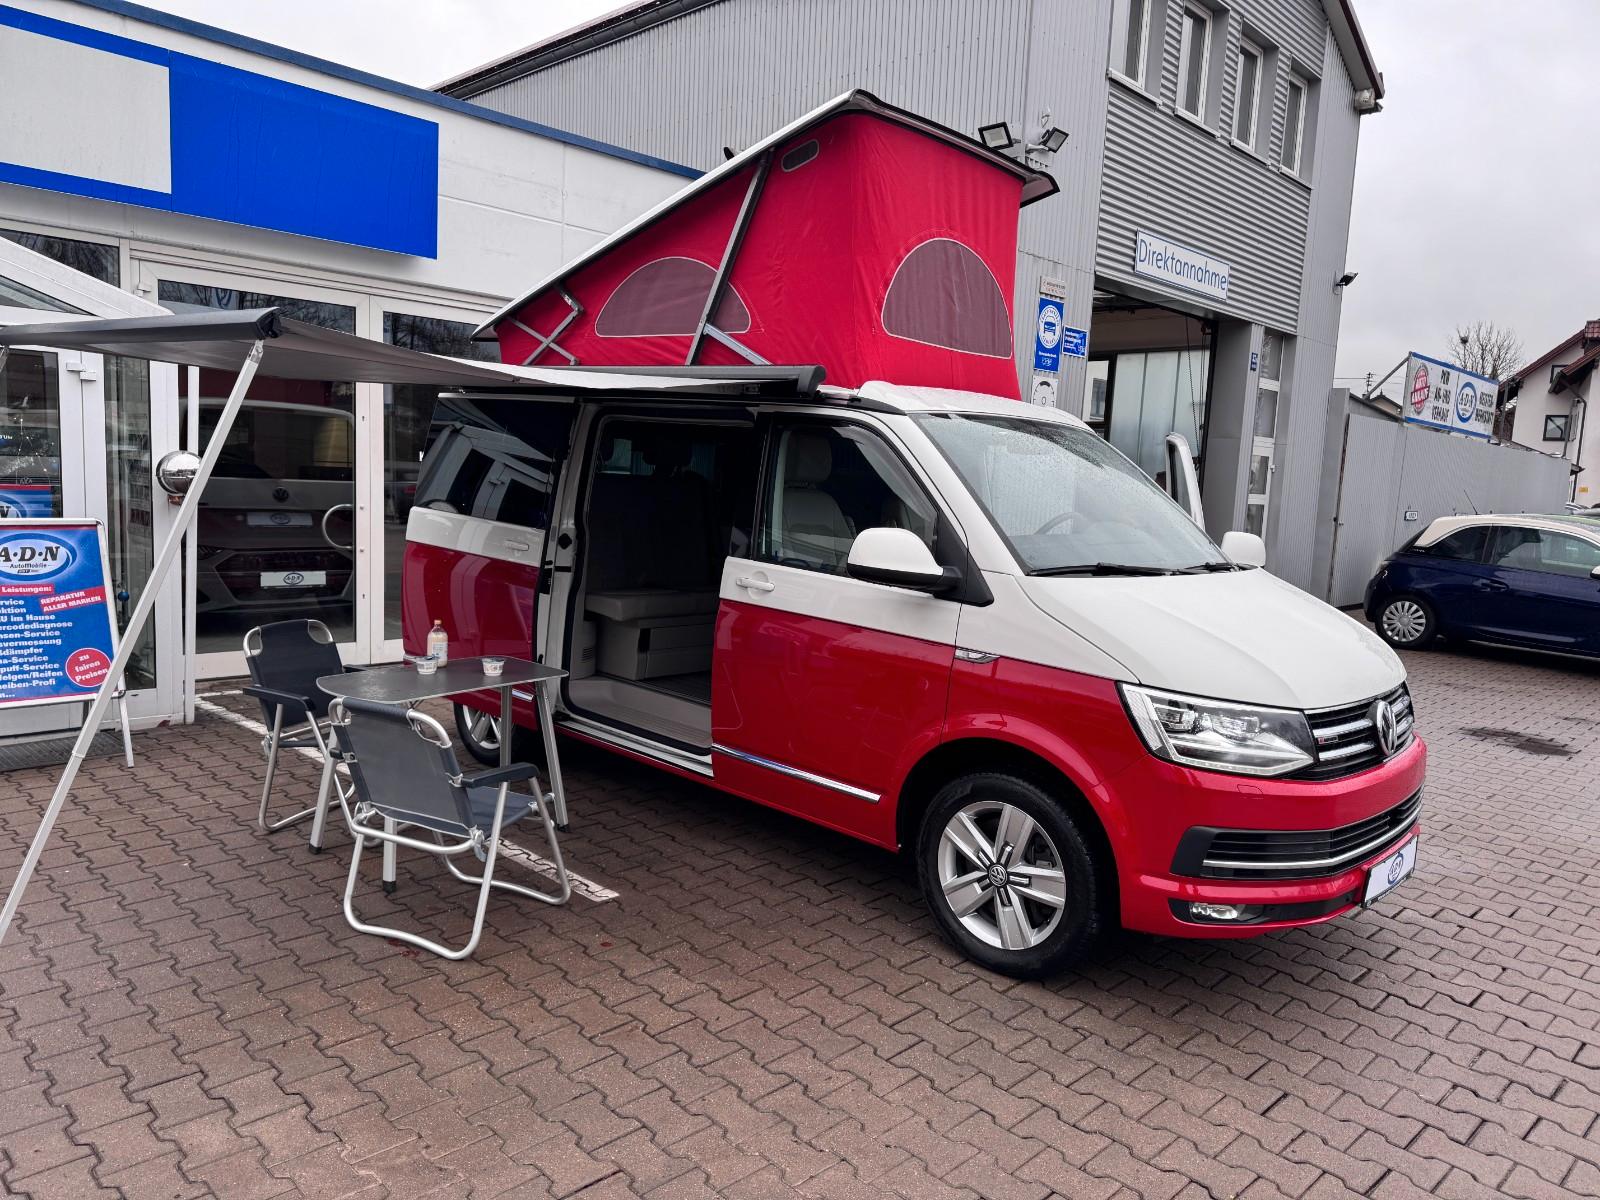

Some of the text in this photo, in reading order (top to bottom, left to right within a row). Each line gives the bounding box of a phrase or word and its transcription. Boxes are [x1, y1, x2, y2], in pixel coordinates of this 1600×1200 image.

[1138, 238, 1227, 291] Direktannahme
[2, 586, 52, 594] Leistungen:
[40, 591, 86, 604] REPARATUR
[43, 596, 102, 612] ALLER MARKEN
[78, 653, 90, 661] zu
[74, 660, 101, 673] fairen
[75, 668, 108, 683] Preisen
